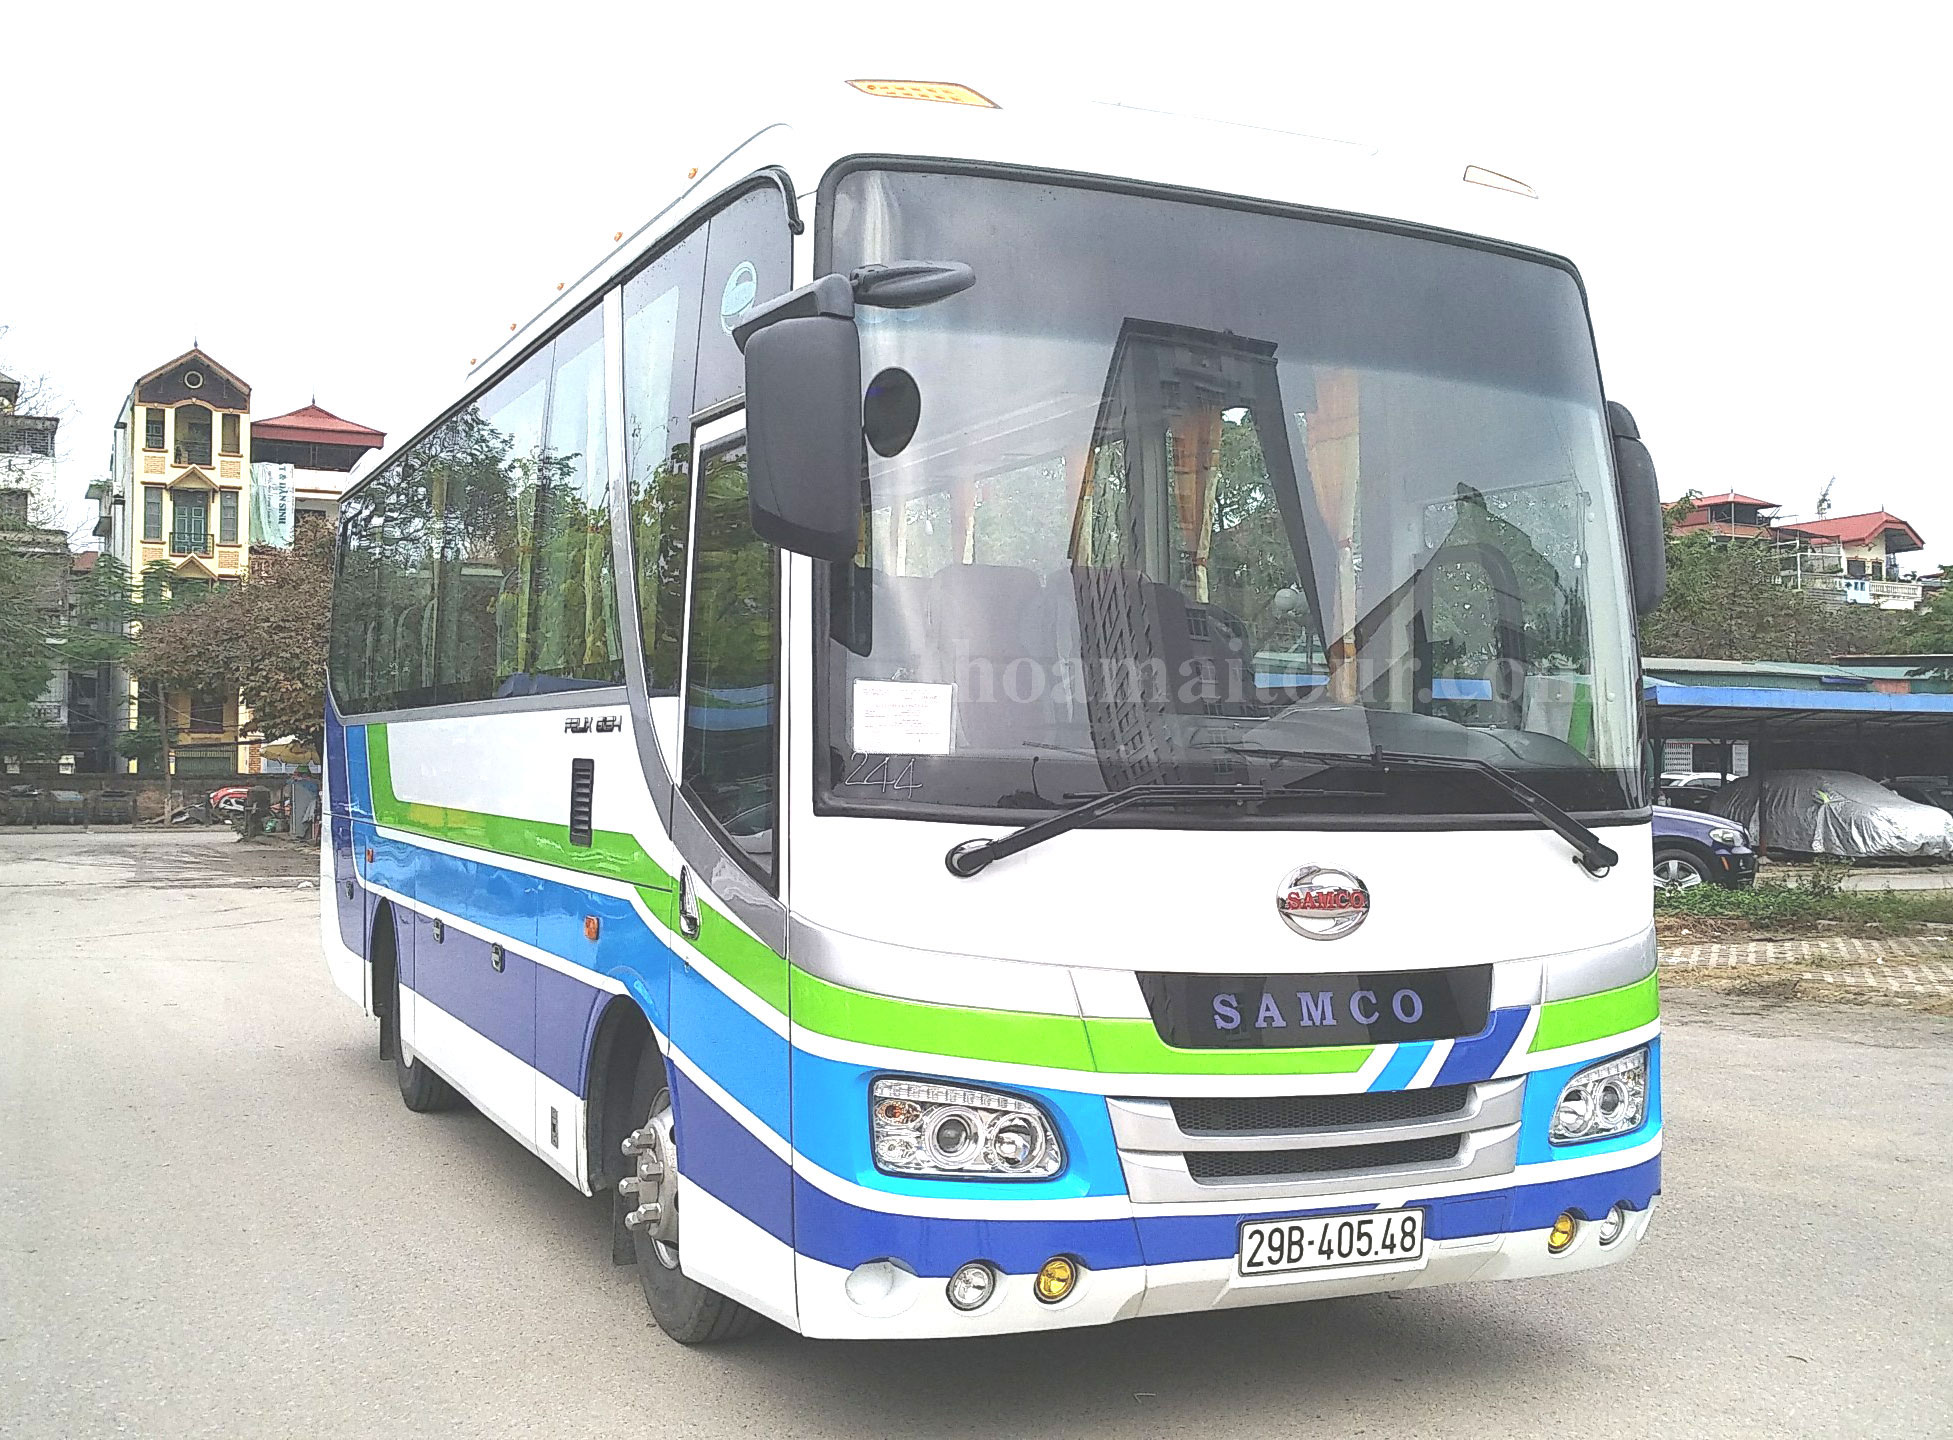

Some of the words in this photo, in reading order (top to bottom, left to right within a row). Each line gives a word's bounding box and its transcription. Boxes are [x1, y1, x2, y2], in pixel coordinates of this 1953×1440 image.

[844, 751, 923, 799] 244
[1287, 891, 1366, 910] SAMCO
[1212, 988, 1425, 1031] SAMCO
[1246, 1215, 1417, 1267] 29B-405.48
